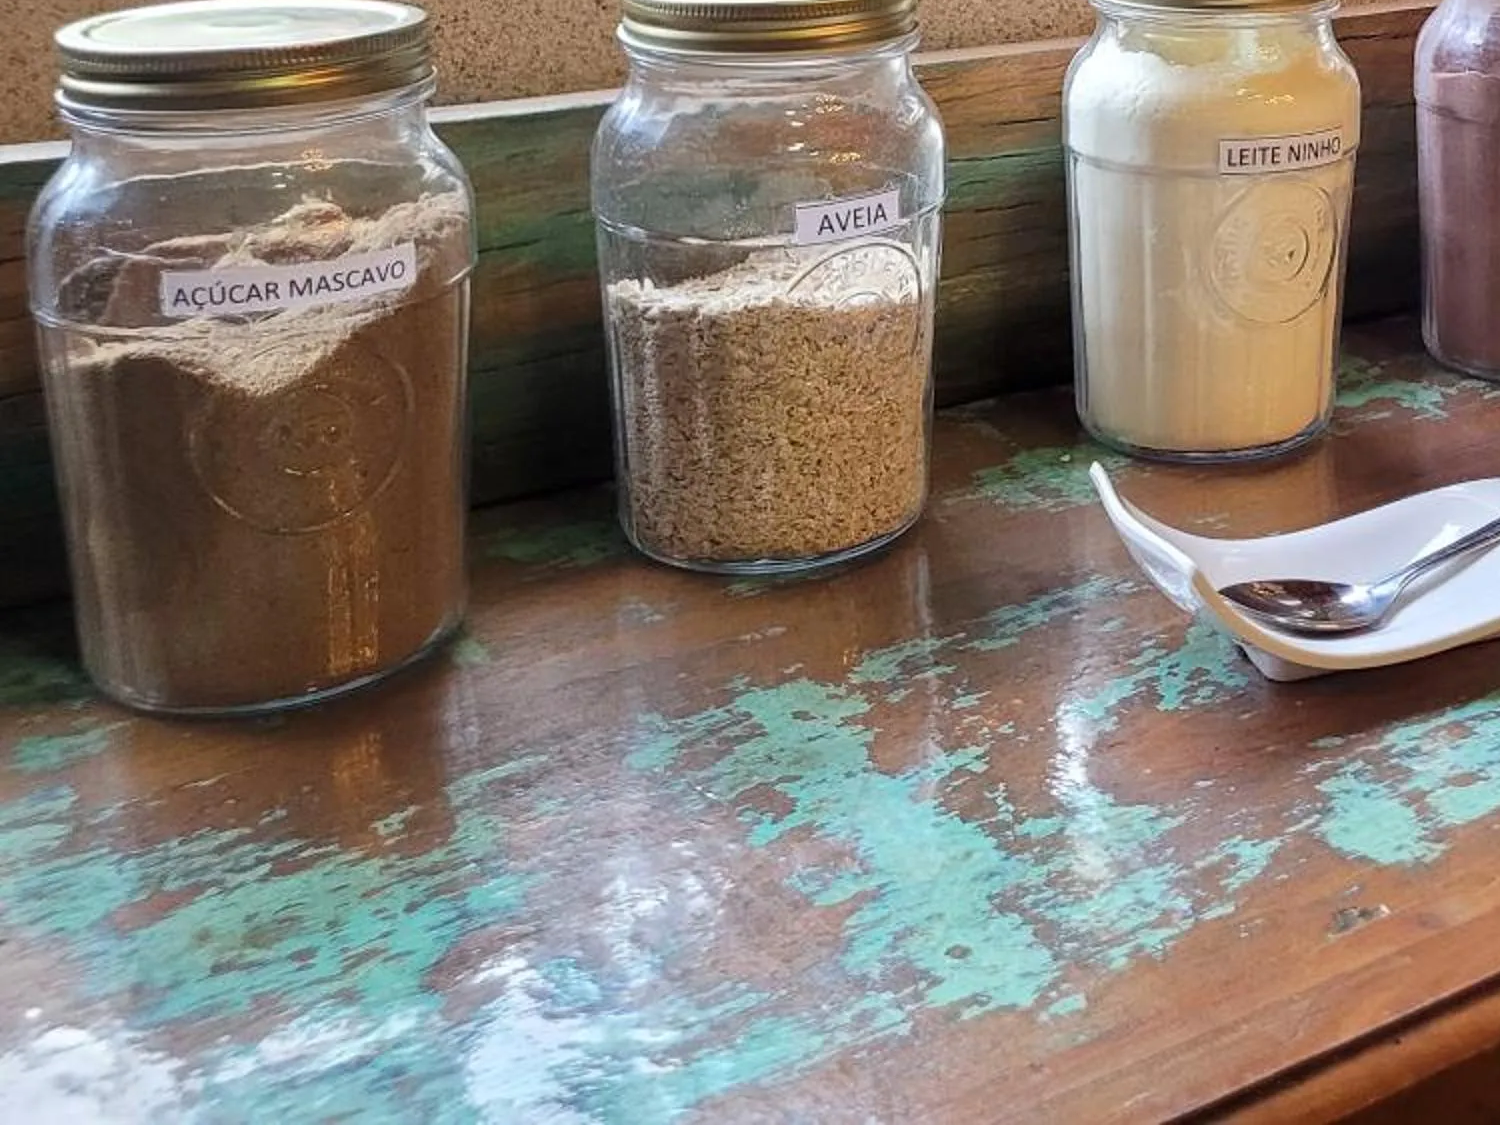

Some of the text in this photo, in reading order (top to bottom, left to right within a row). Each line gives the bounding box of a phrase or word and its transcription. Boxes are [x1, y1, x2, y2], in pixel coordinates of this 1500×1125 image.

[1226, 135, 1342, 168] LEITE NINHO
[817, 202, 888, 236] AVEIA
[172, 259, 406, 311] AÇÚCAR MASCAVO
